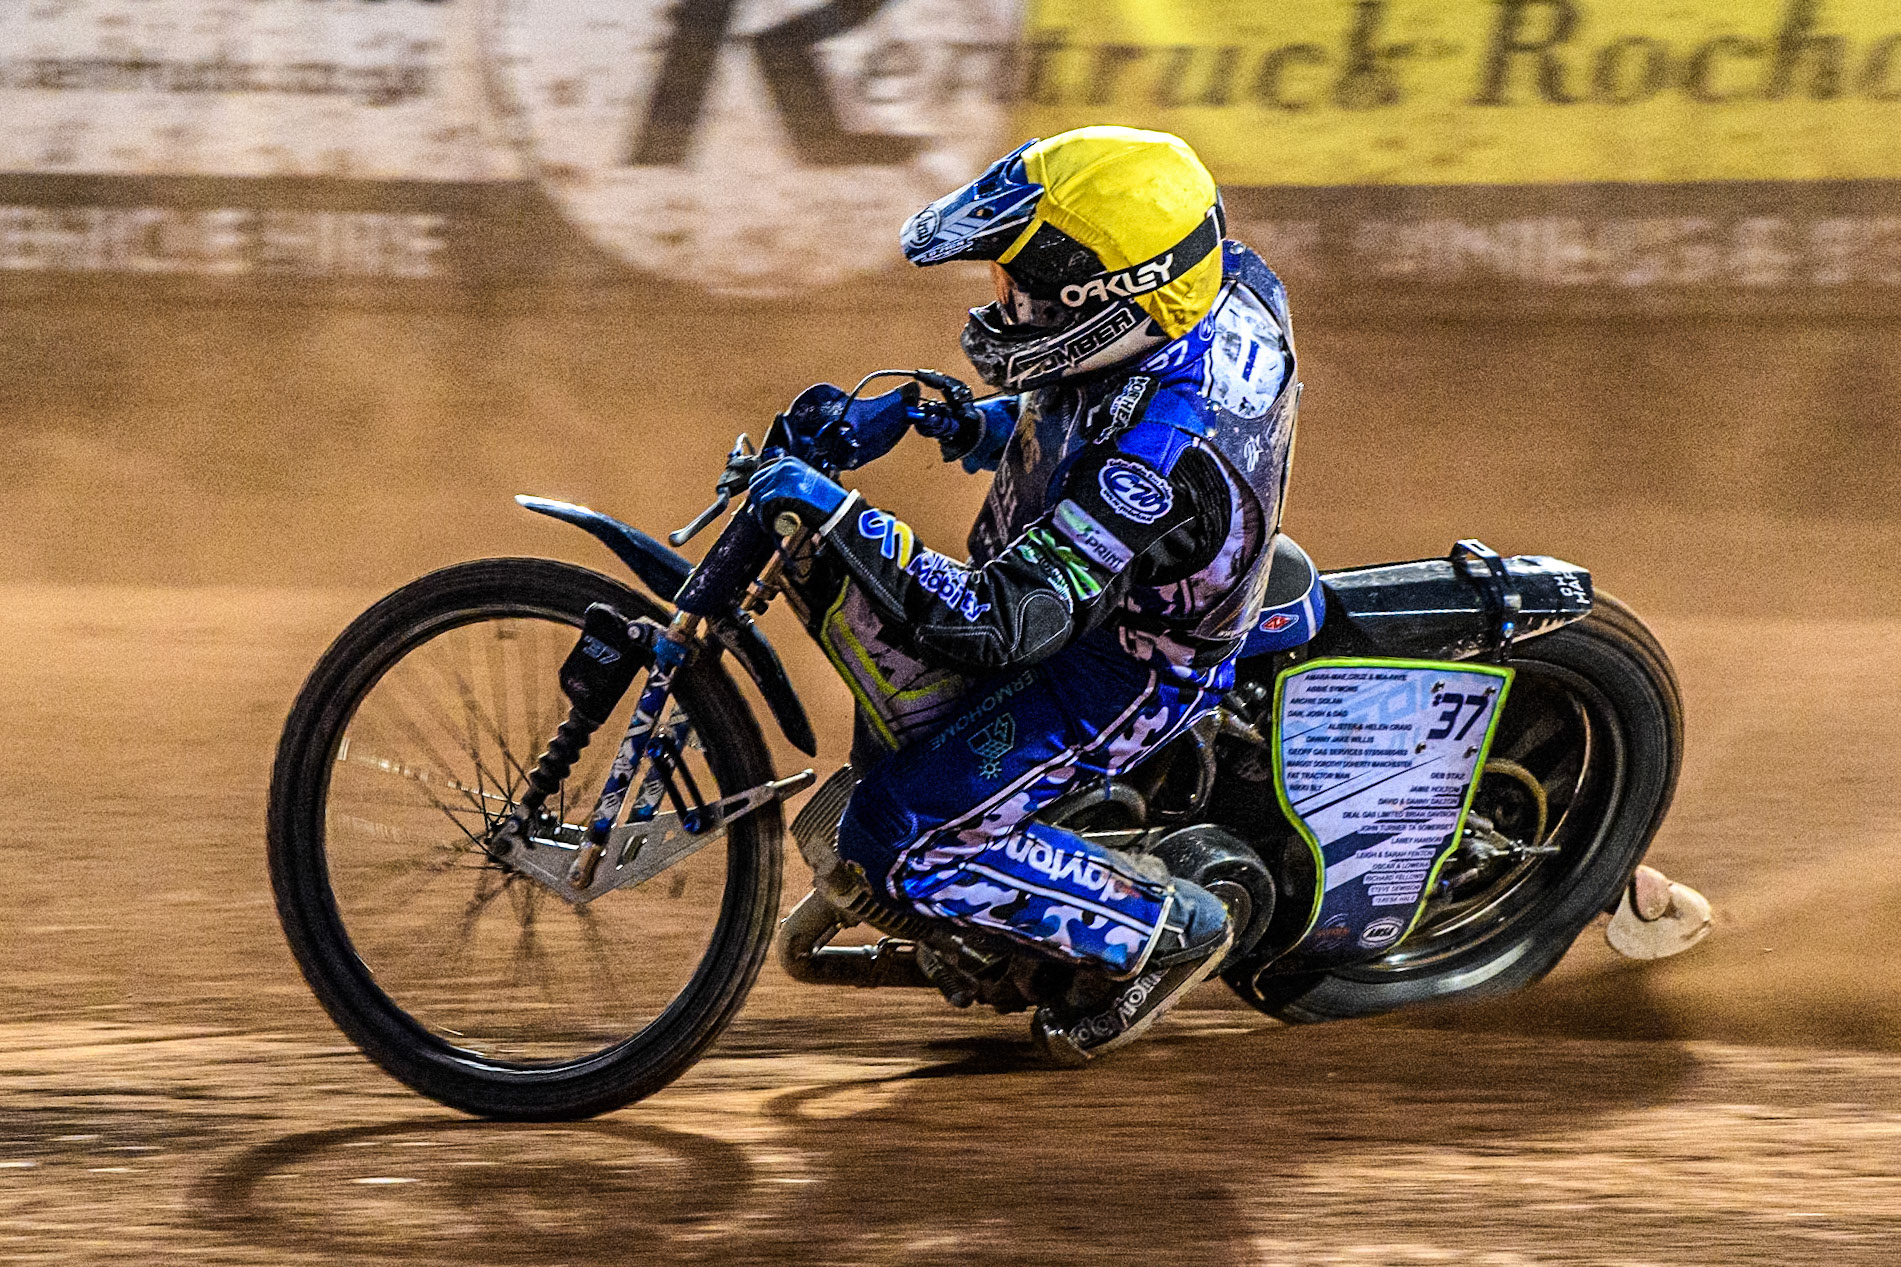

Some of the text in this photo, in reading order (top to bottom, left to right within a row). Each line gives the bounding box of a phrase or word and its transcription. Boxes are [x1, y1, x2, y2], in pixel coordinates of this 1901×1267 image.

[1060, 253, 1174, 308] OAKLEY
[1427, 693, 1490, 741] 37
[1301, 772, 1333, 780] TRACTOR
